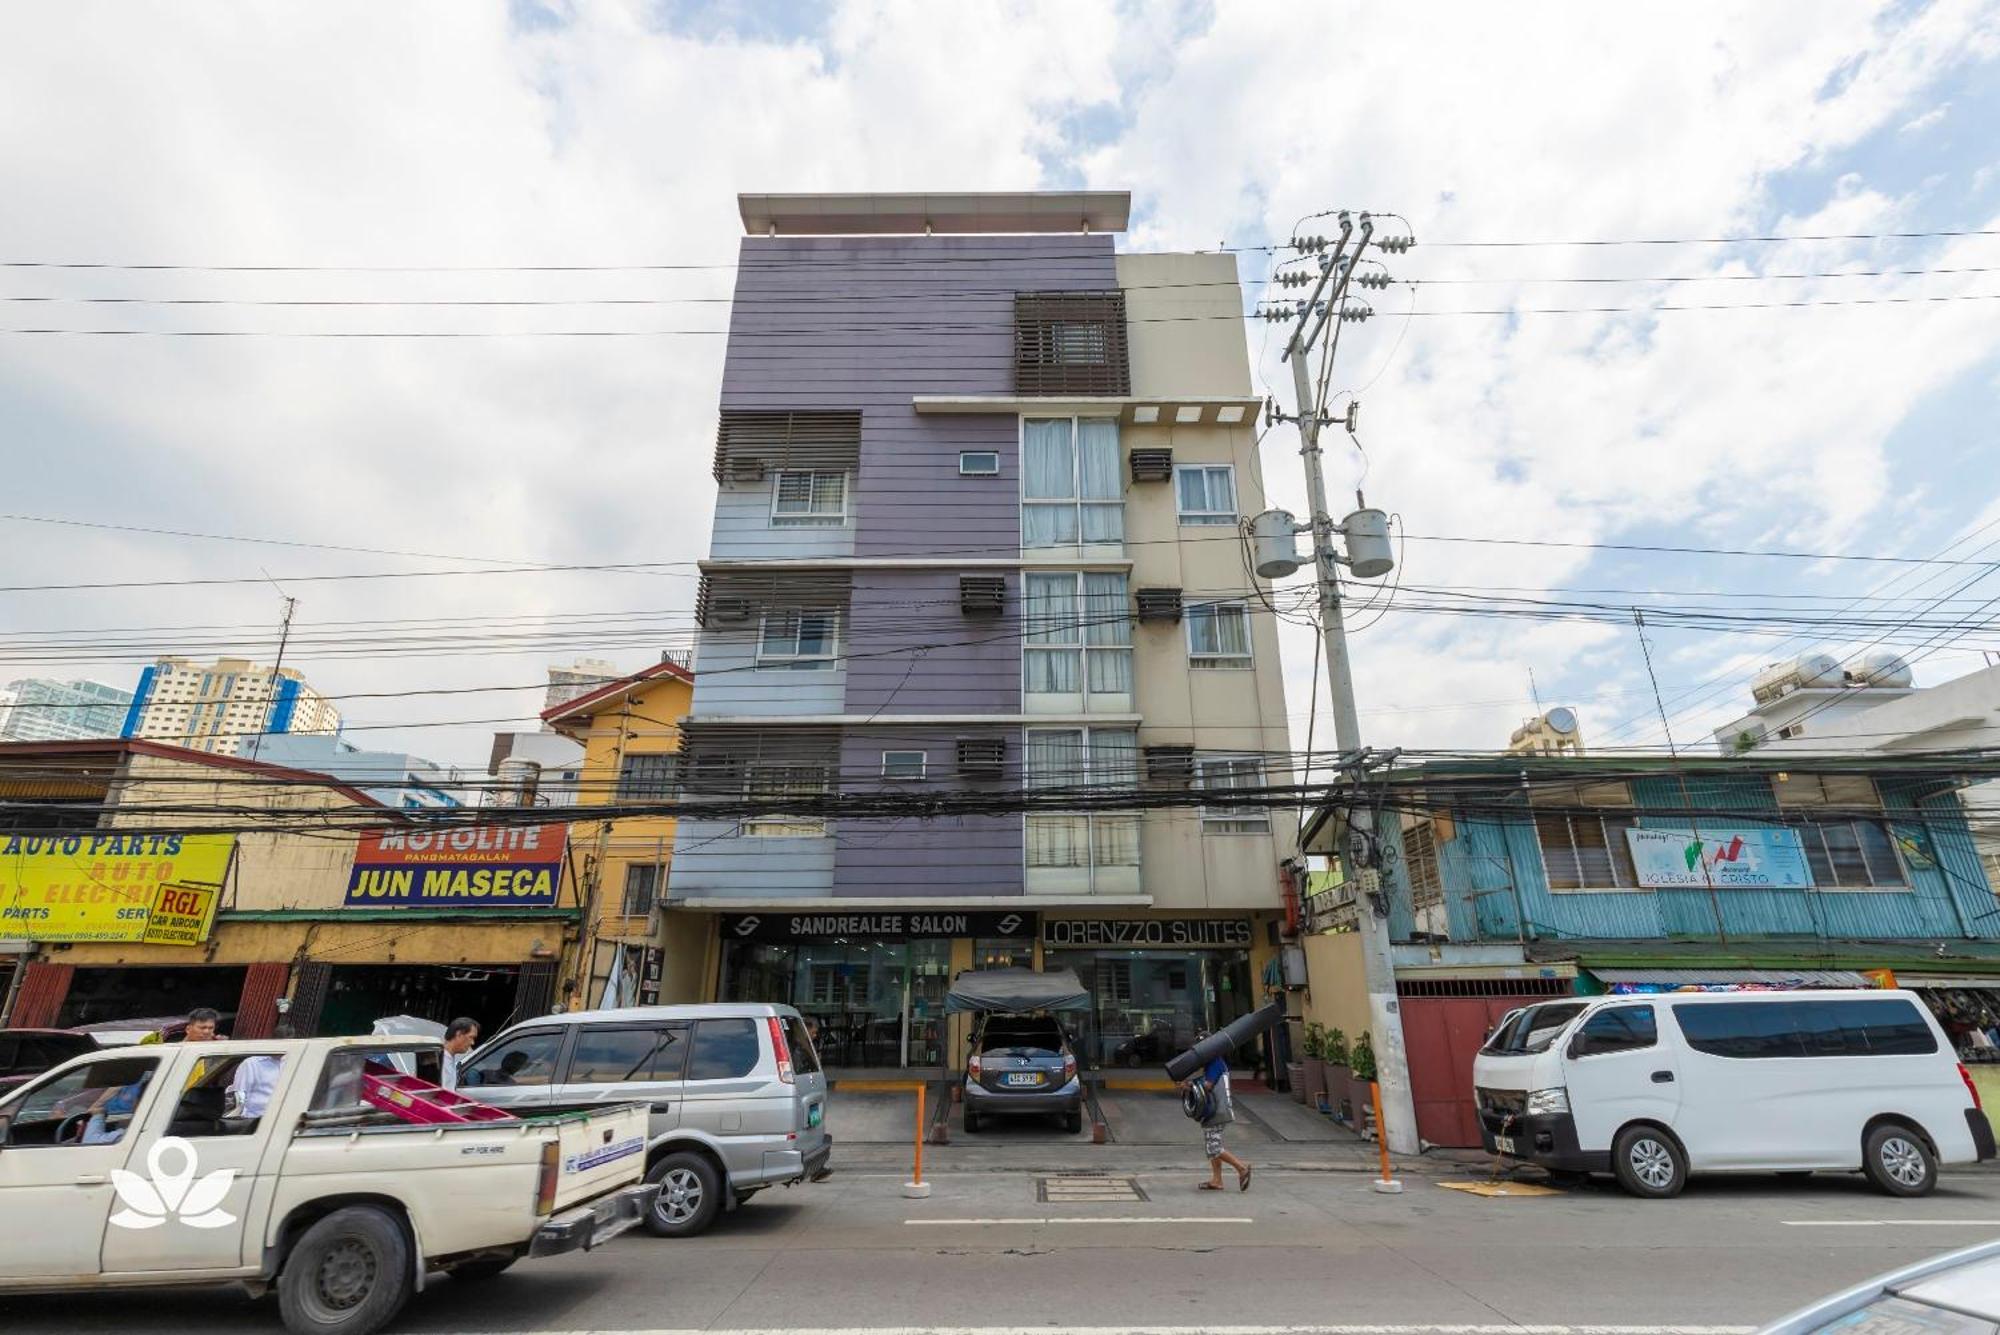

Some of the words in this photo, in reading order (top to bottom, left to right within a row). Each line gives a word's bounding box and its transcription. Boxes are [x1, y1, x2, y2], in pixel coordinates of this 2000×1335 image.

[2, 833, 82, 855] AUTO
[87, 832, 183, 856] PARTS
[378, 826, 542, 851] MOTOLITE
[90, 861, 174, 881] AUTO
[351, 870, 414, 897] JUN
[421, 869, 552, 897] MASECA
[3, 907, 50, 919] PARTS
[159, 889, 202, 916] RGL
[152, 915, 168, 926] CAR
[171, 917, 200, 928] AIRCON
[790, 915, 903, 935] SANDREALEE
[909, 915, 968, 933] SALON
[1044, 919, 1162, 944] LORENZZO
[1172, 921, 1250, 943] SUITES
